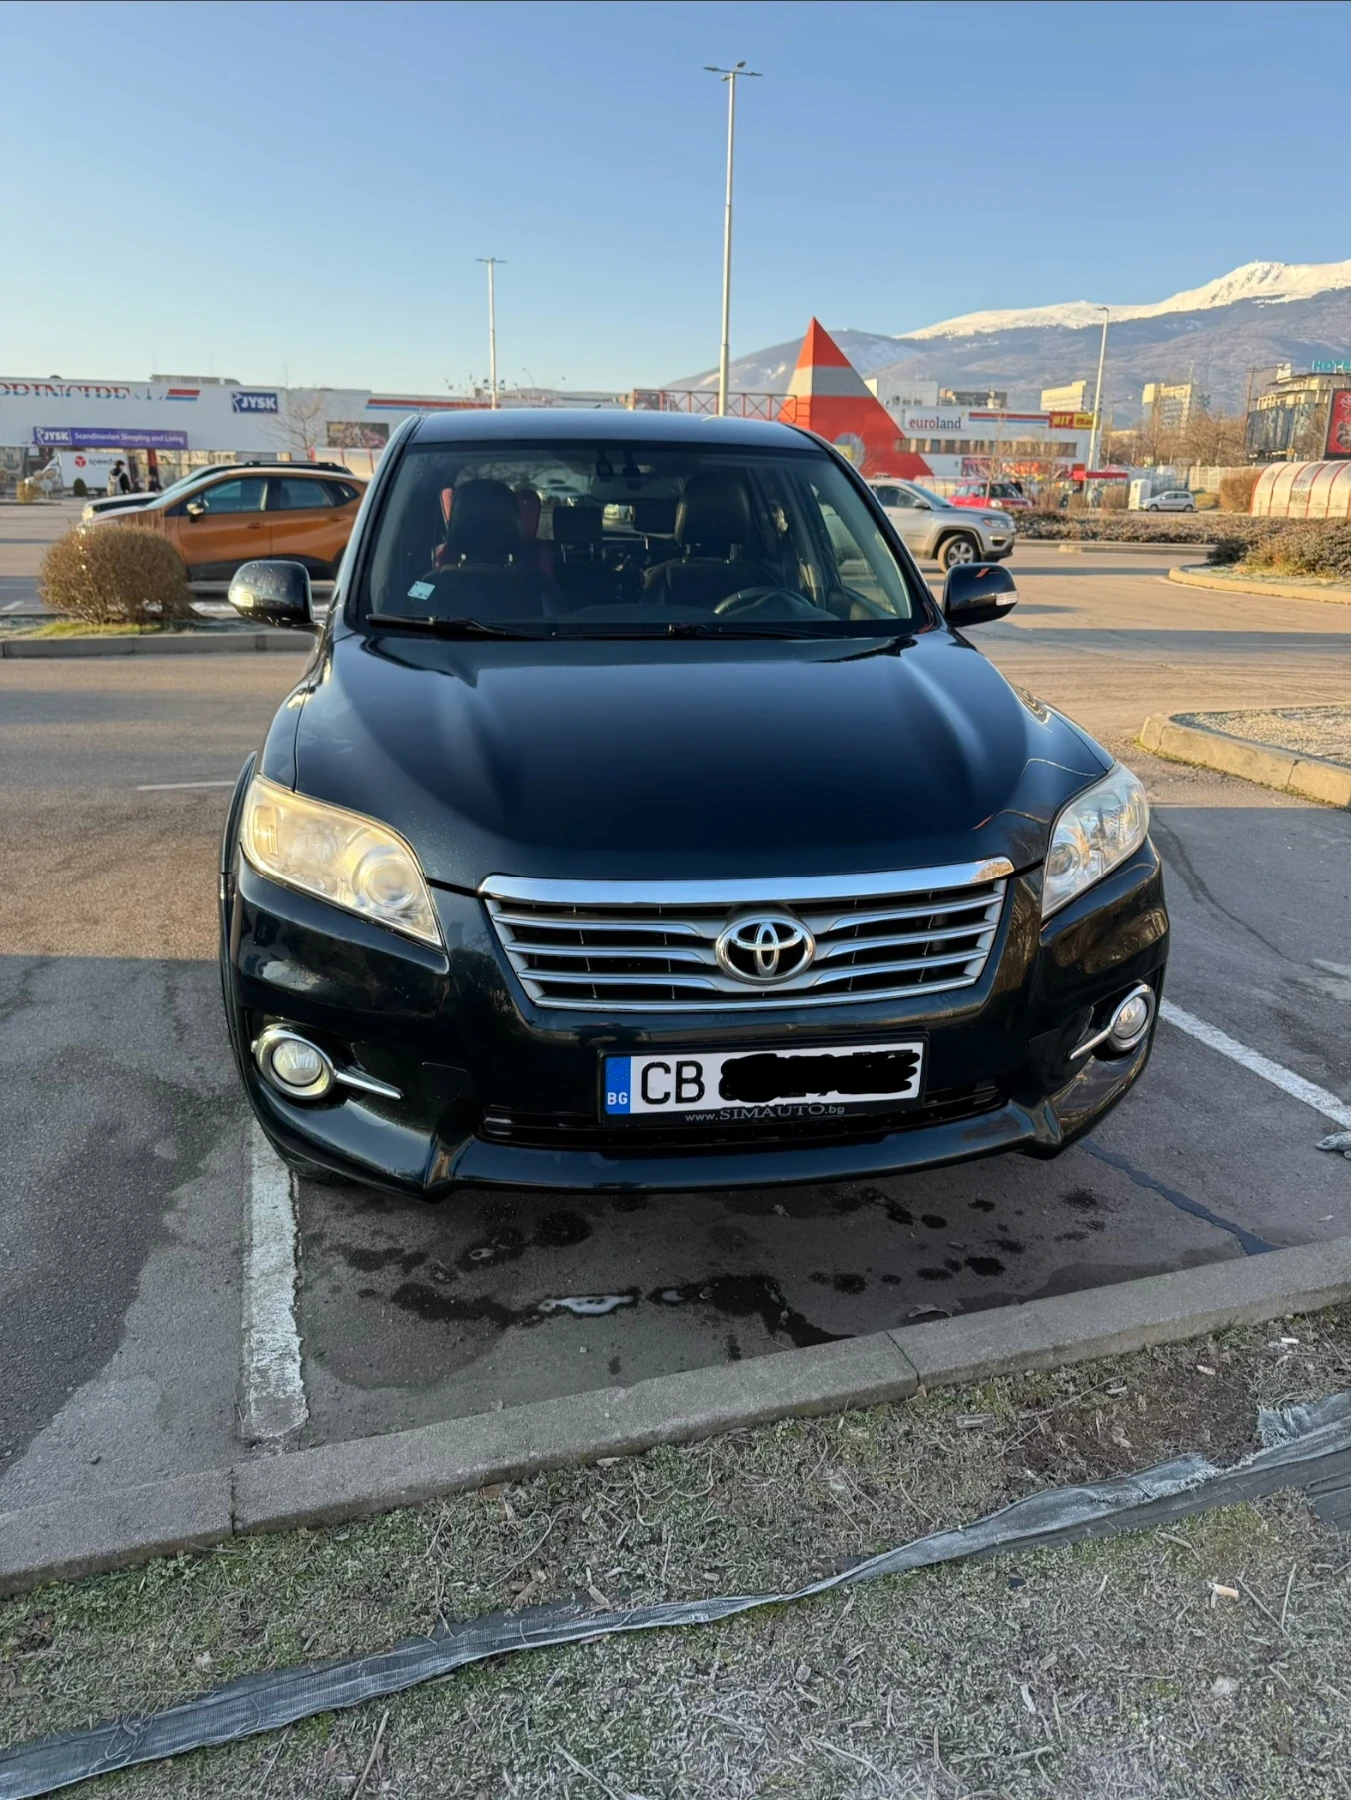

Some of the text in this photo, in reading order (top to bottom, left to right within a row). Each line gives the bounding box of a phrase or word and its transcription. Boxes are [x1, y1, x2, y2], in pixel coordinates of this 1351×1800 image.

[241, 396, 276, 409] JYSK
[909, 416, 961, 429] euroland
[43, 431, 69, 441] JYSK
[641, 1060, 705, 1104] CB
[607, 1092, 628, 1105] BG
[685, 1103, 845, 1121] www.SIMAUTO.bg
